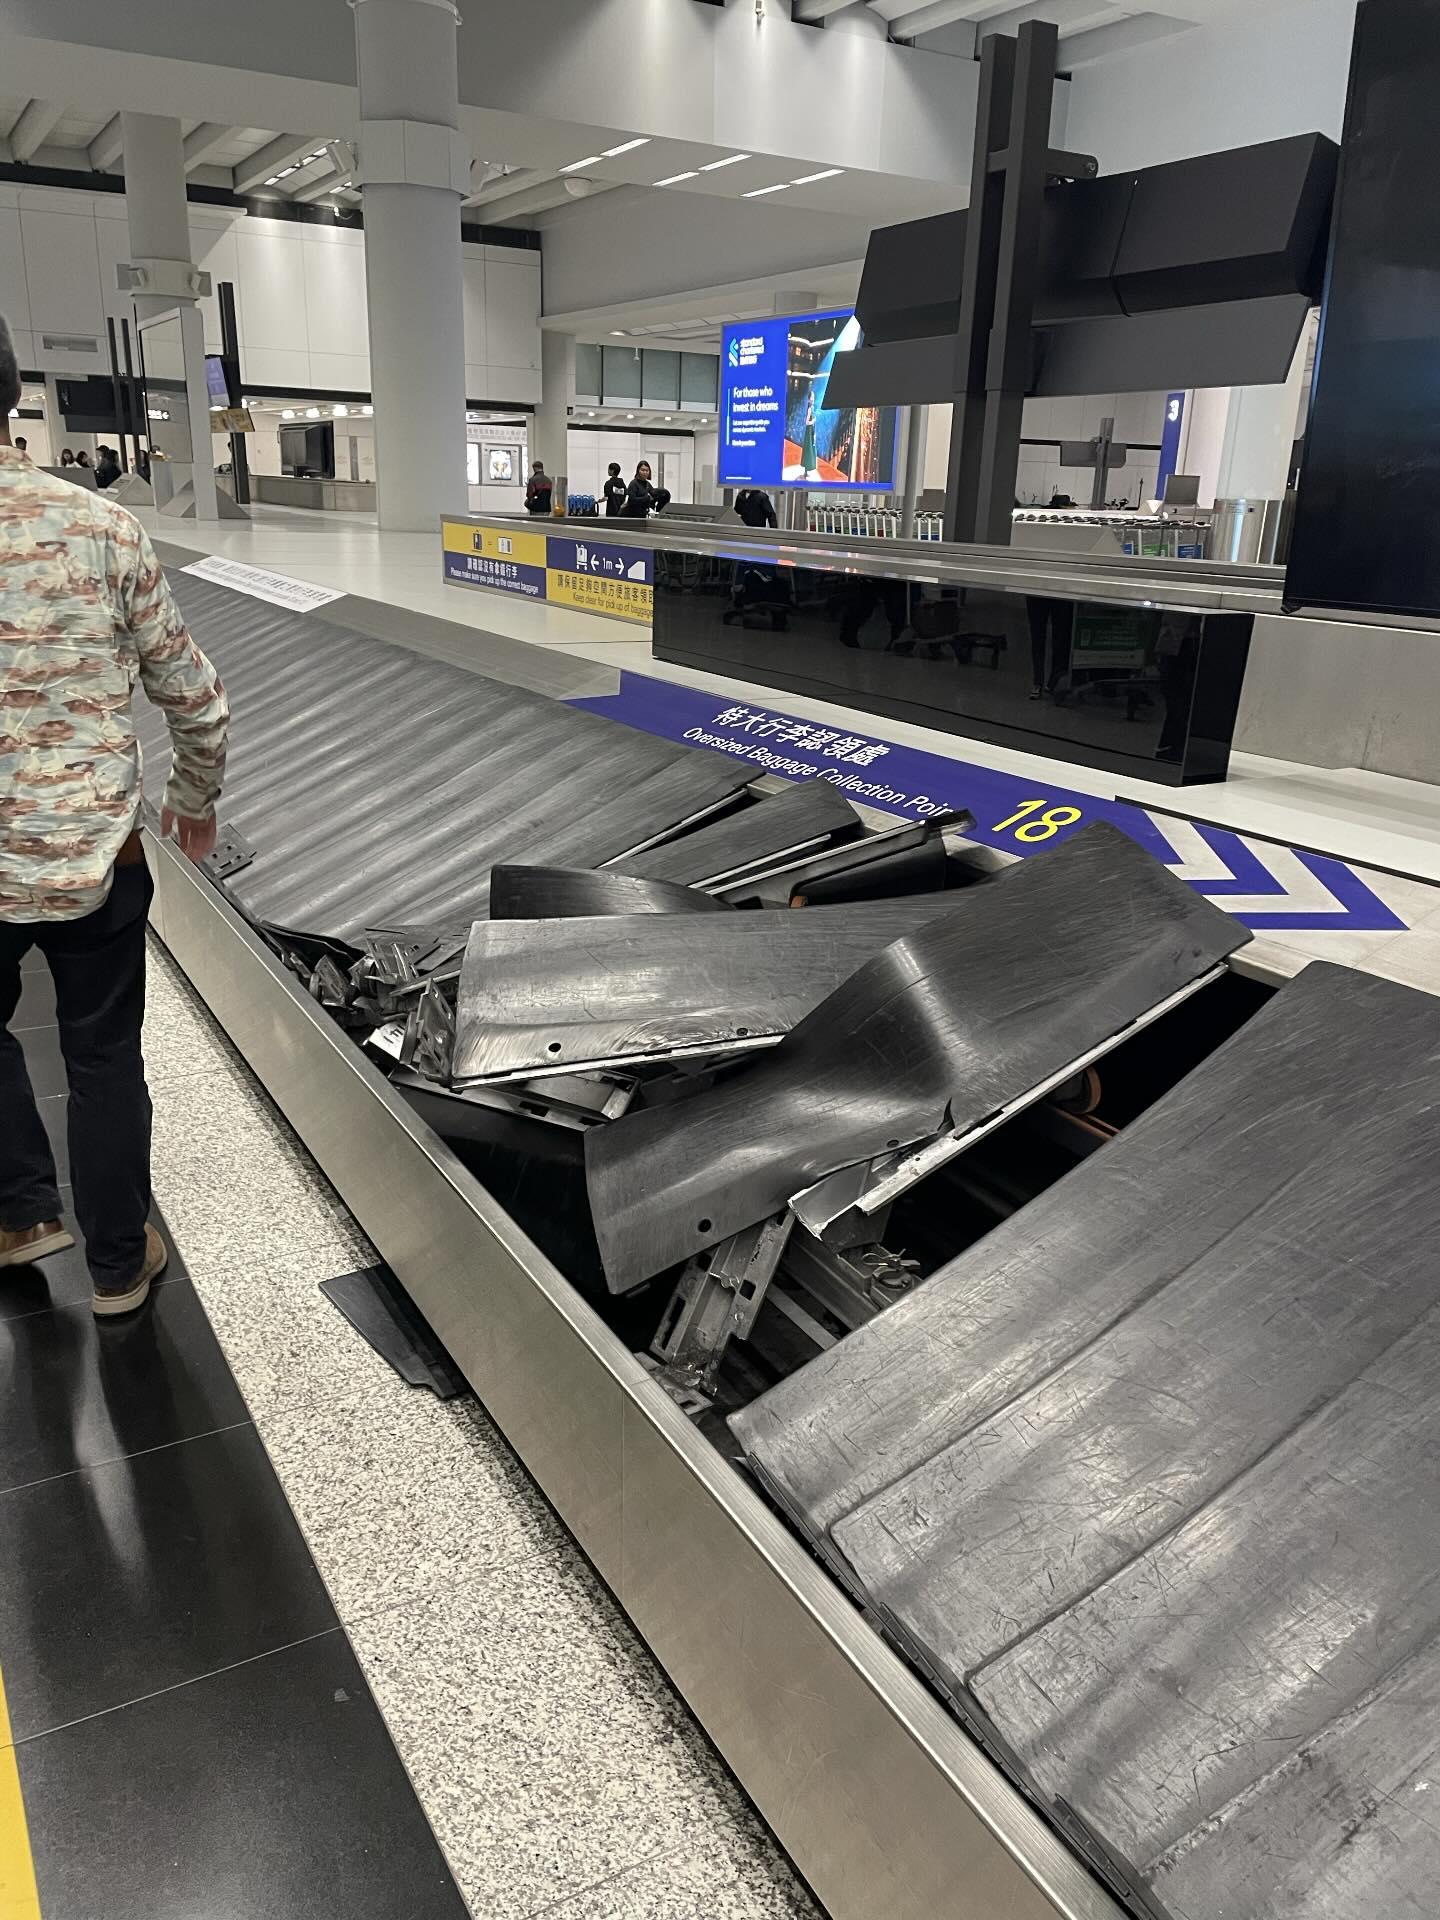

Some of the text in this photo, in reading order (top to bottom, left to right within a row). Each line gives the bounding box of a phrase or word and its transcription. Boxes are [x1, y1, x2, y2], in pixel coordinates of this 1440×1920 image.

[759, 385, 773, 397] who
[733, 402, 749, 412] invest
[756, 400, 779, 411] dreams
[602, 557, 613, 570] 1m
[606, 600, 614, 610] pick
[616, 604, 624, 612] up
[712, 706, 891, 767] 特大行李認領處
[683, 727, 754, 755] Oversized
[747, 747, 817, 777] Baggage
[817, 767, 906, 805] Collection
[992, 800, 1082, 842] 18
